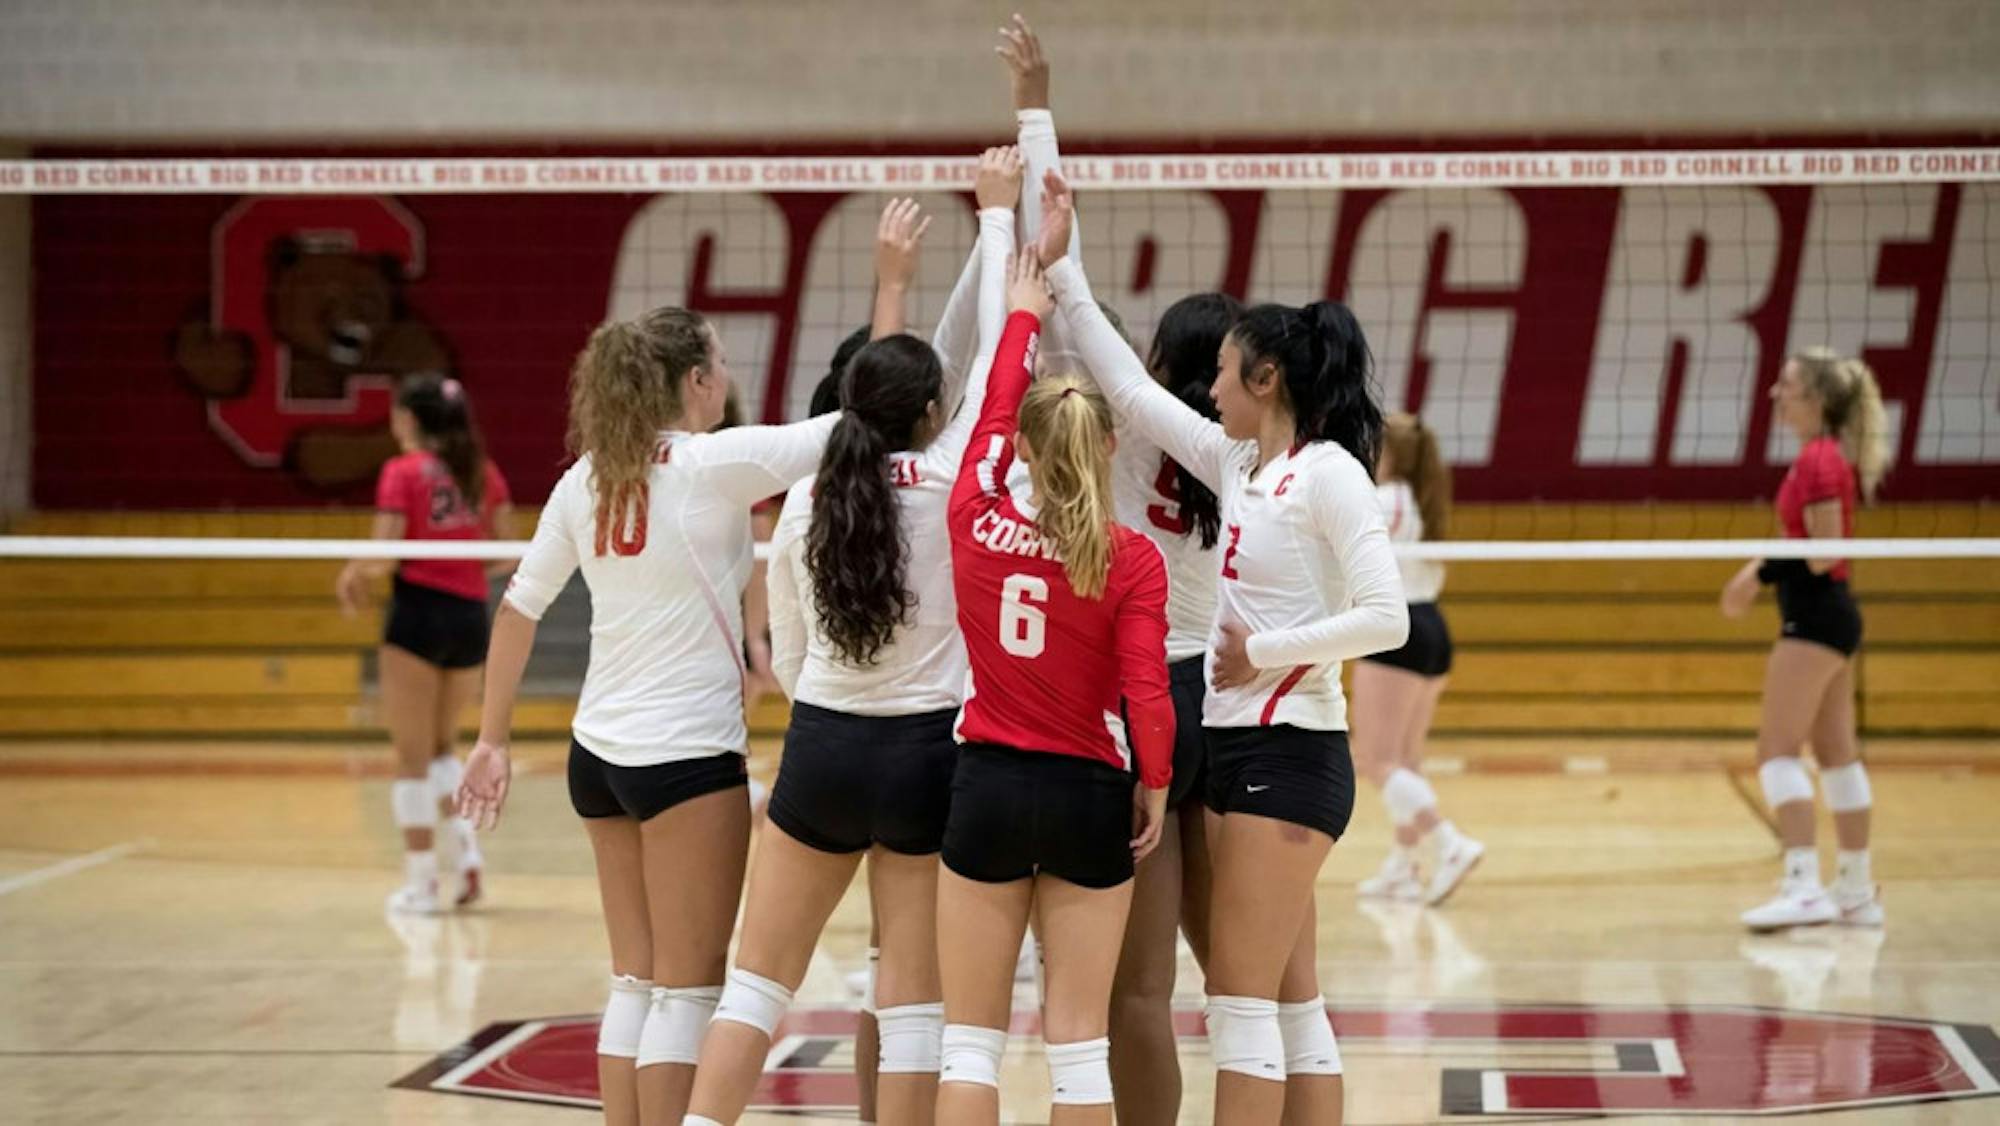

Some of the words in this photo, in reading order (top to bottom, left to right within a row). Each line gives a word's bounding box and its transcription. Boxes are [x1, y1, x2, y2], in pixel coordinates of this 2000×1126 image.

[0, 168, 24, 185] IG
[34, 168, 78, 185] RED
[88, 167, 199, 185] CORNELL
[208, 167, 248, 184] BIG
[258, 167, 302, 184] RED
[312, 166, 421, 184] CORNELL
[434, 166, 473, 183] BIG
[482, 166, 527, 183] RED
[536, 165, 648, 183] CORNELL
[658, 165, 698, 182] BIG
[707, 165, 754, 182] RED
[763, 164, 875, 182] CORNELL
[884, 164, 923, 181] BIG
[1112, 162, 1150, 180] BIG
[1161, 162, 1207, 179] RED
[1216, 161, 1329, 179] CORNELL
[1341, 161, 1379, 178] BIG
[1390, 160, 1436, 178] RED
[1446, 160, 1560, 177] CORNELL
[1570, 159, 1611, 176] BIG
[1620, 159, 1667, 176] RED
[1676, 158, 1792, 175] CORNELL
[1802, 157, 1842, 175] BIG
[1854, 157, 1900, 174] RED
[1910, 156, 2000, 173] CORNE
[1275, 474, 1295, 497] C
[594, 478, 650, 557] 10
[972, 508, 1065, 563] CORN
[1000, 573, 1048, 658] 6
